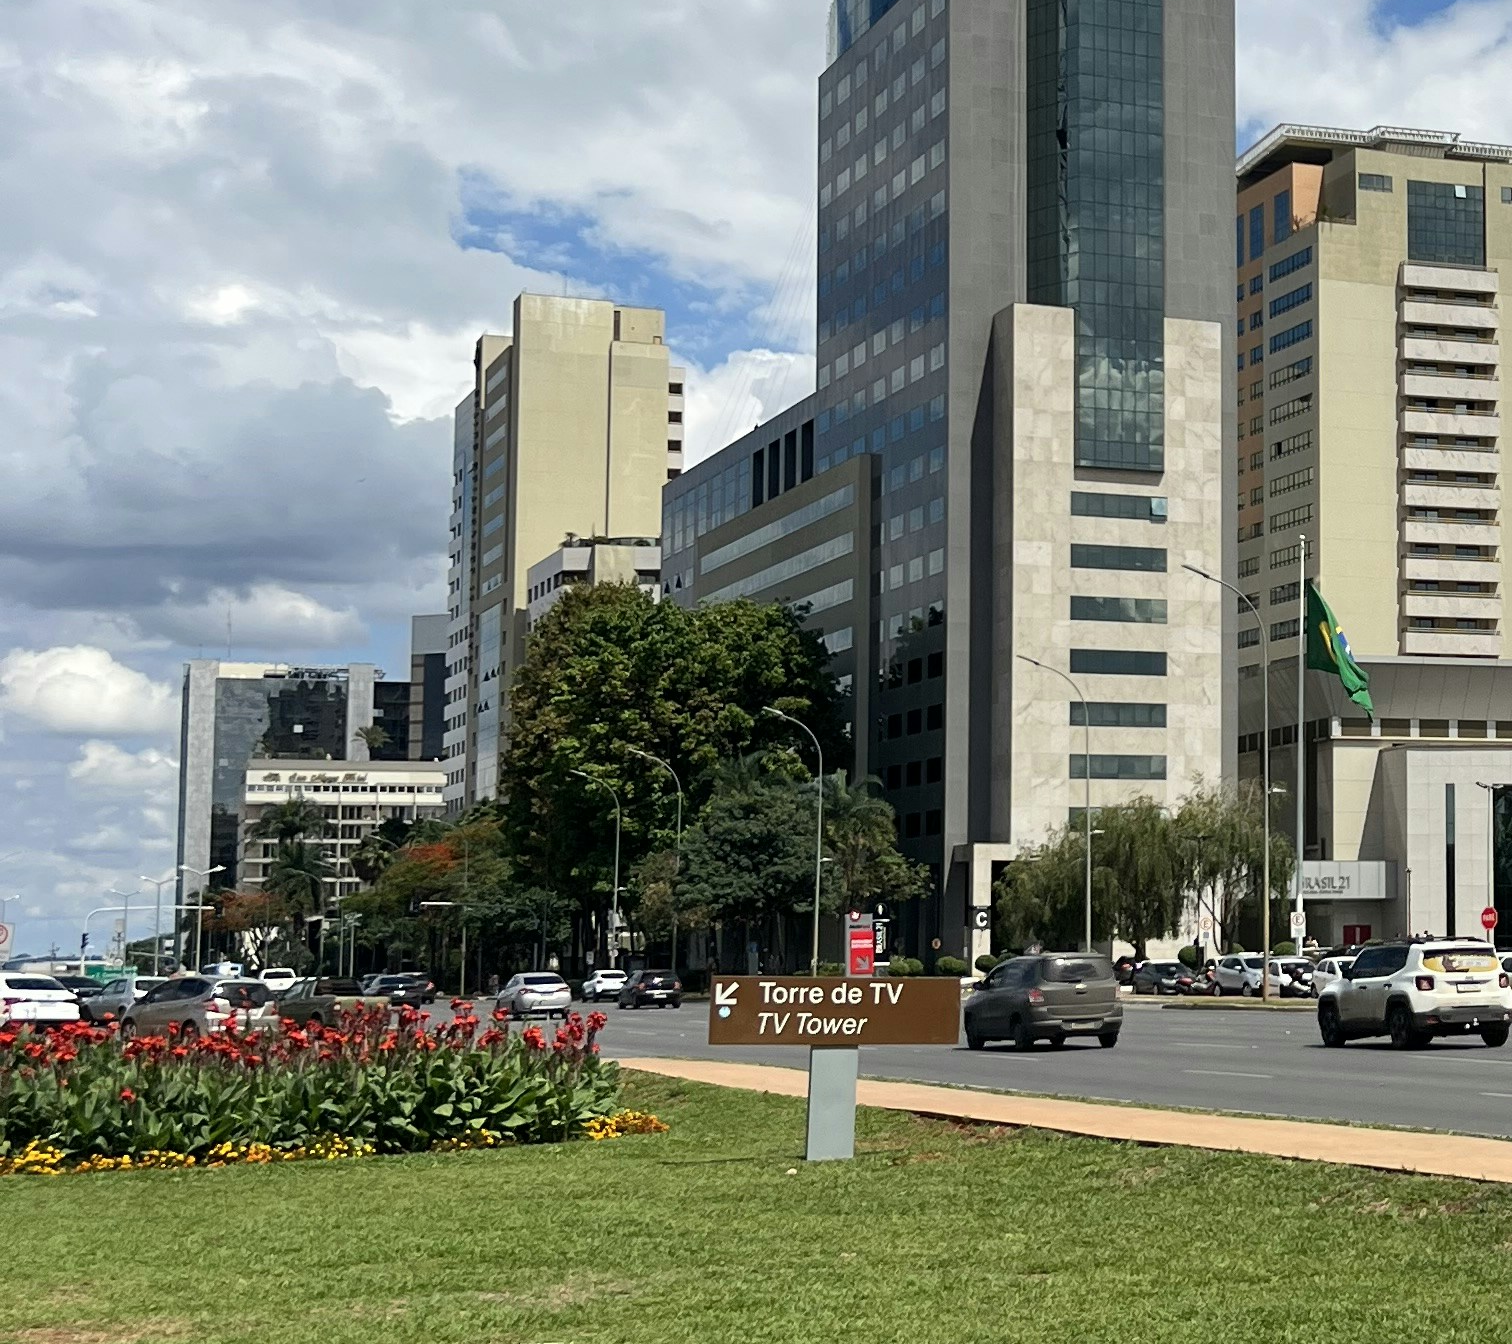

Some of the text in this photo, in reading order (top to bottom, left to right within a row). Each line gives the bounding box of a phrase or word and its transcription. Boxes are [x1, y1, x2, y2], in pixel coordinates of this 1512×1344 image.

[1302, 876, 1350, 889] RASIL 21
[976, 912, 988, 927] C
[759, 981, 904, 1005] Torre de TV
[758, 1013, 868, 1035] TV Tower
